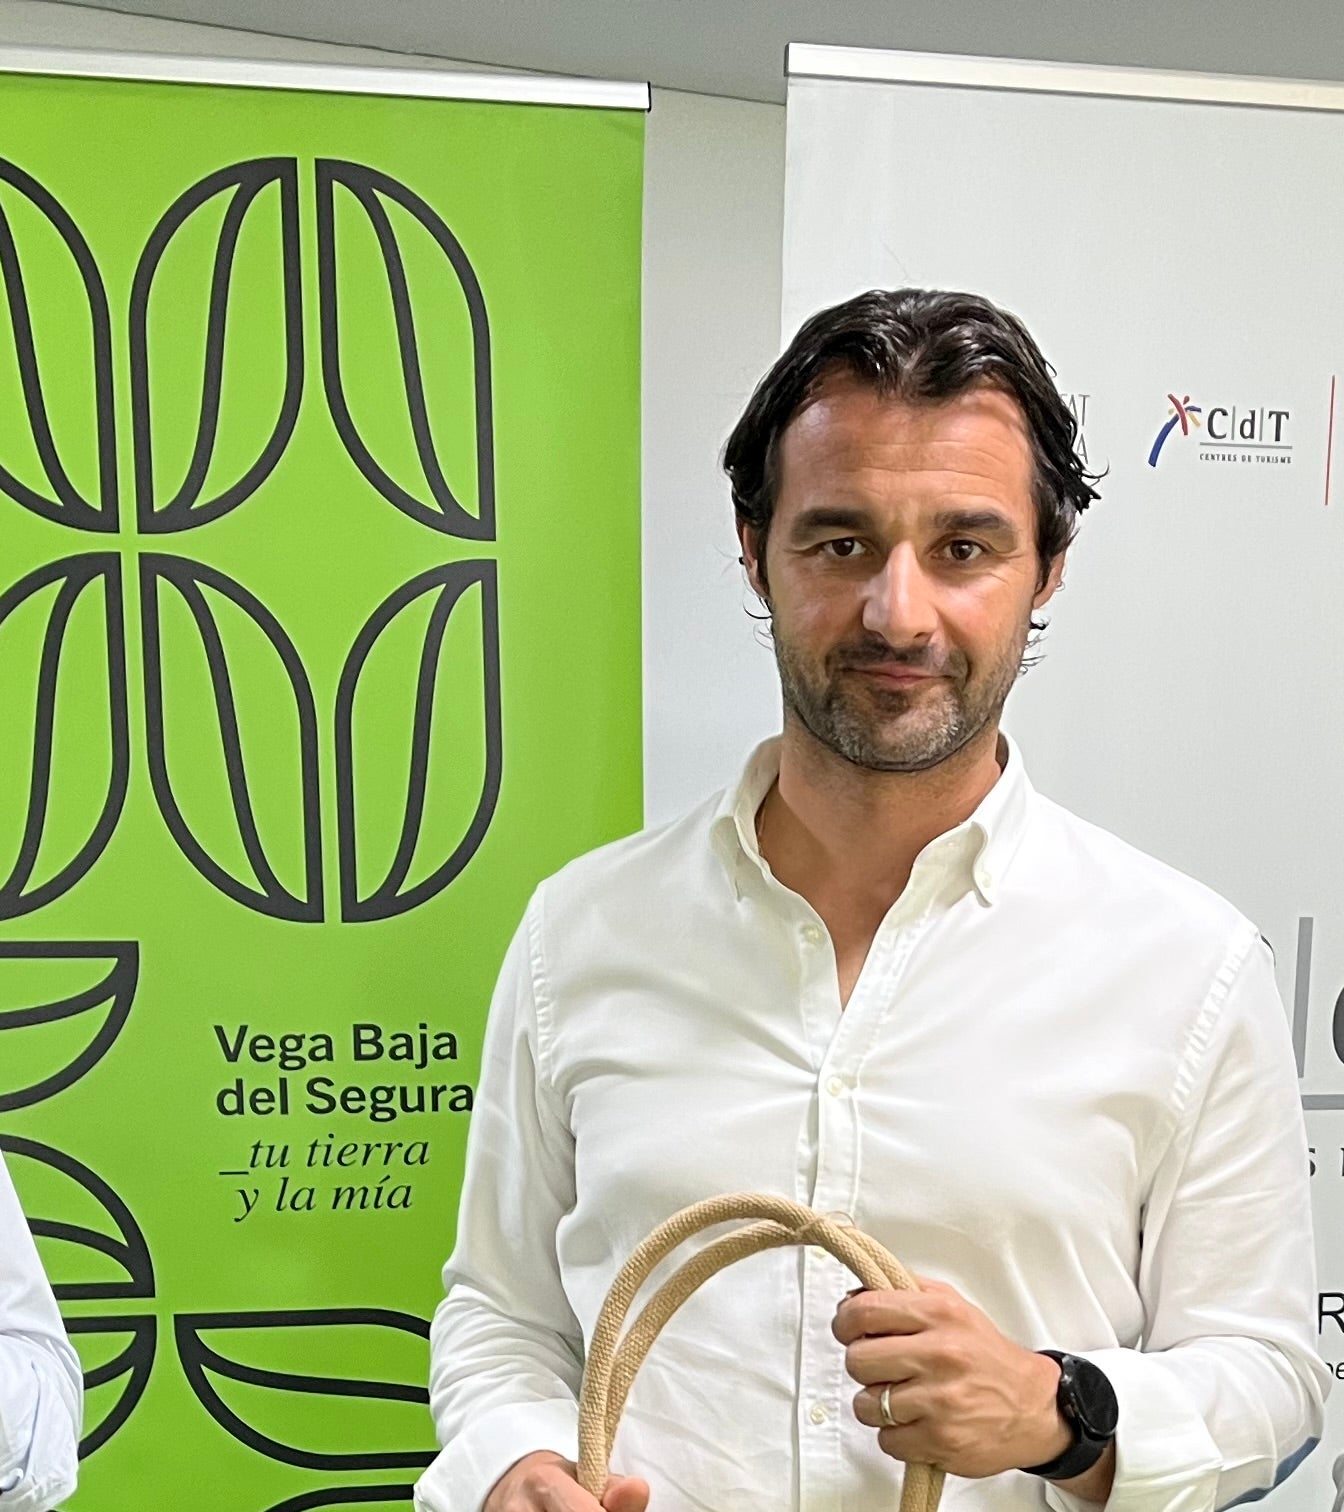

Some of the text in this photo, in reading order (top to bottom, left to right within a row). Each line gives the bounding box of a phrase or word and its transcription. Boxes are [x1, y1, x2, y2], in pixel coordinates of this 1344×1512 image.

[1200, 453, 1292, 464] CENTRES DE TURISME
[213, 1022, 458, 1071] Vega Baja
[216, 1077, 474, 1122] del Segura
[306, 1133, 430, 1169] tierra
[233, 1174, 413, 1223] y la mía
